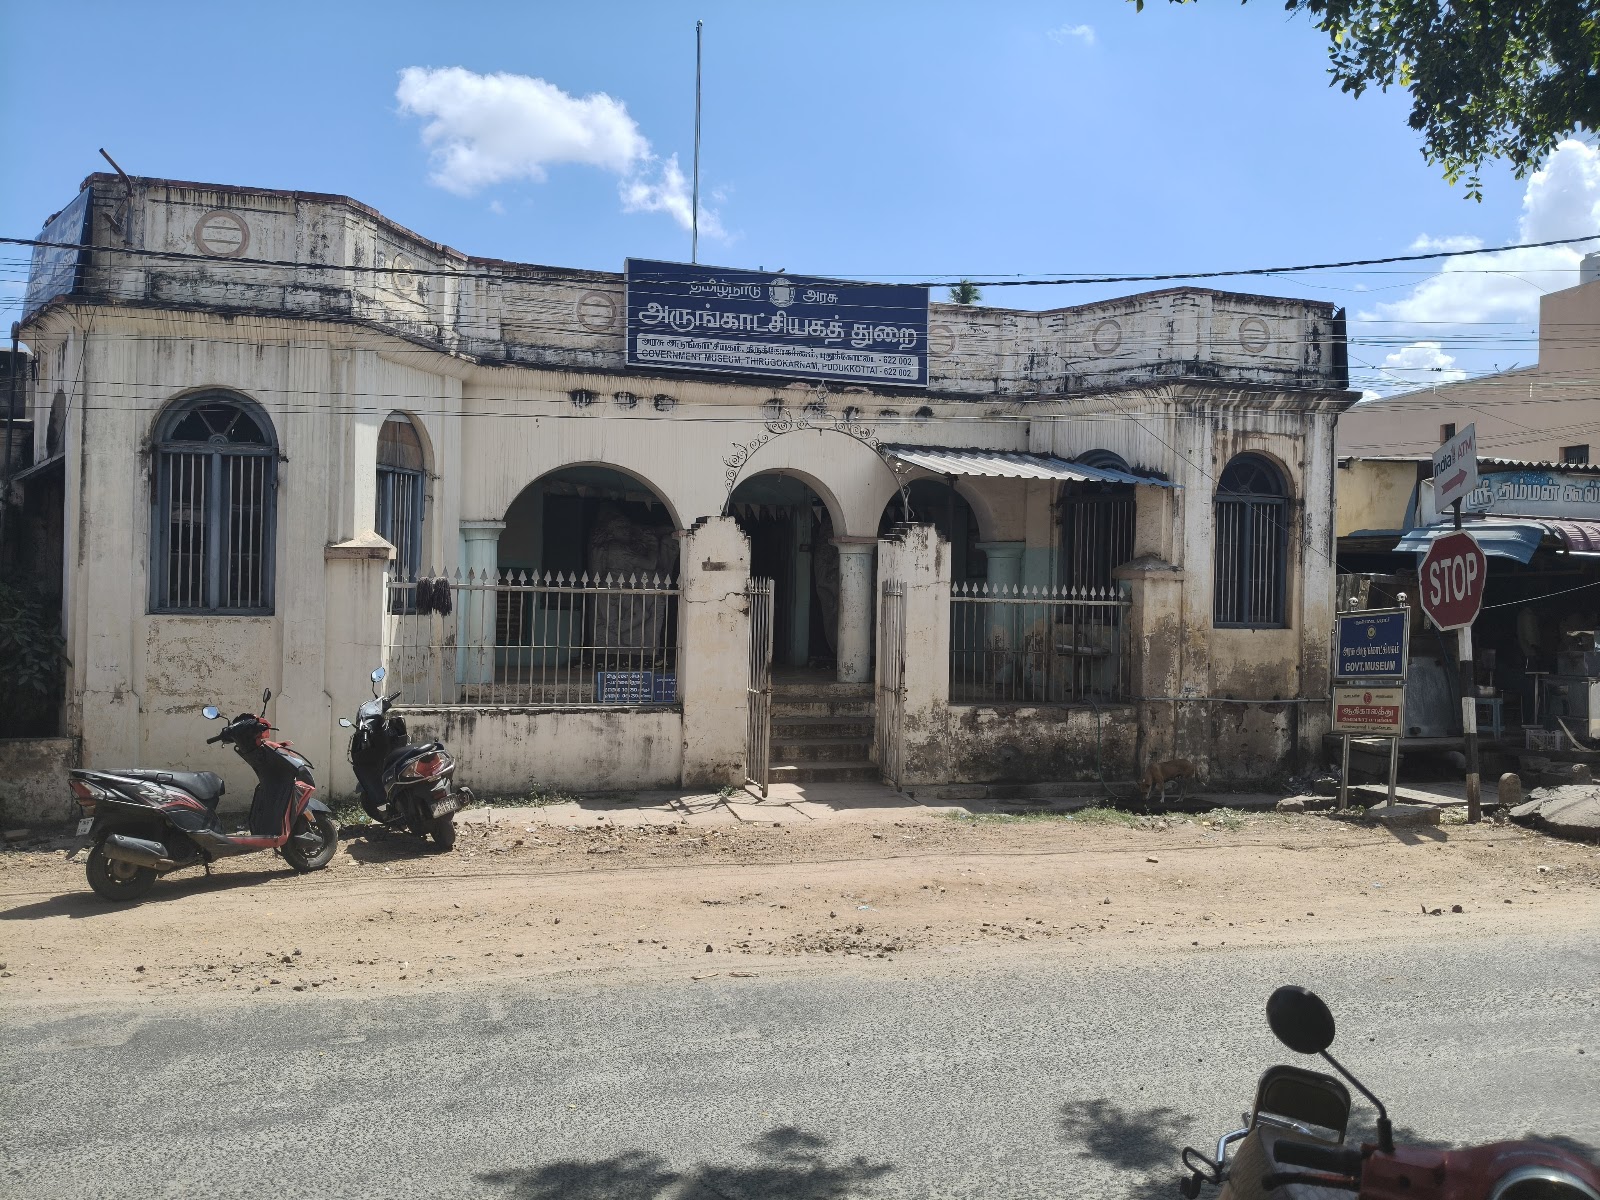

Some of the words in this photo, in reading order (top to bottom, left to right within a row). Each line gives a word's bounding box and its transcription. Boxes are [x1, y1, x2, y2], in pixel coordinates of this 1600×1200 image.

[689, 278, 761, 299] தமிழ்நாடு
[803, 289, 838, 305] அரசு
[638, 302, 845, 345] அருங்காட்சியகத்
[850, 323, 917, 350] துறை
[641, 338, 665, 347] அரசு
[883, 355, 897, 365] 622
[641, 349, 703, 362] GOVERNMENT
[704, 352, 744, 366] MUSEUM,
[822, 363, 878, 375] PUDUKKOTTAI
[883, 367, 897, 377] 622
[1457, 435, 1473, 461] ATM
[1498, 477, 1560, 501] அம்மன்
[1429, 552, 1478, 606] STOP
